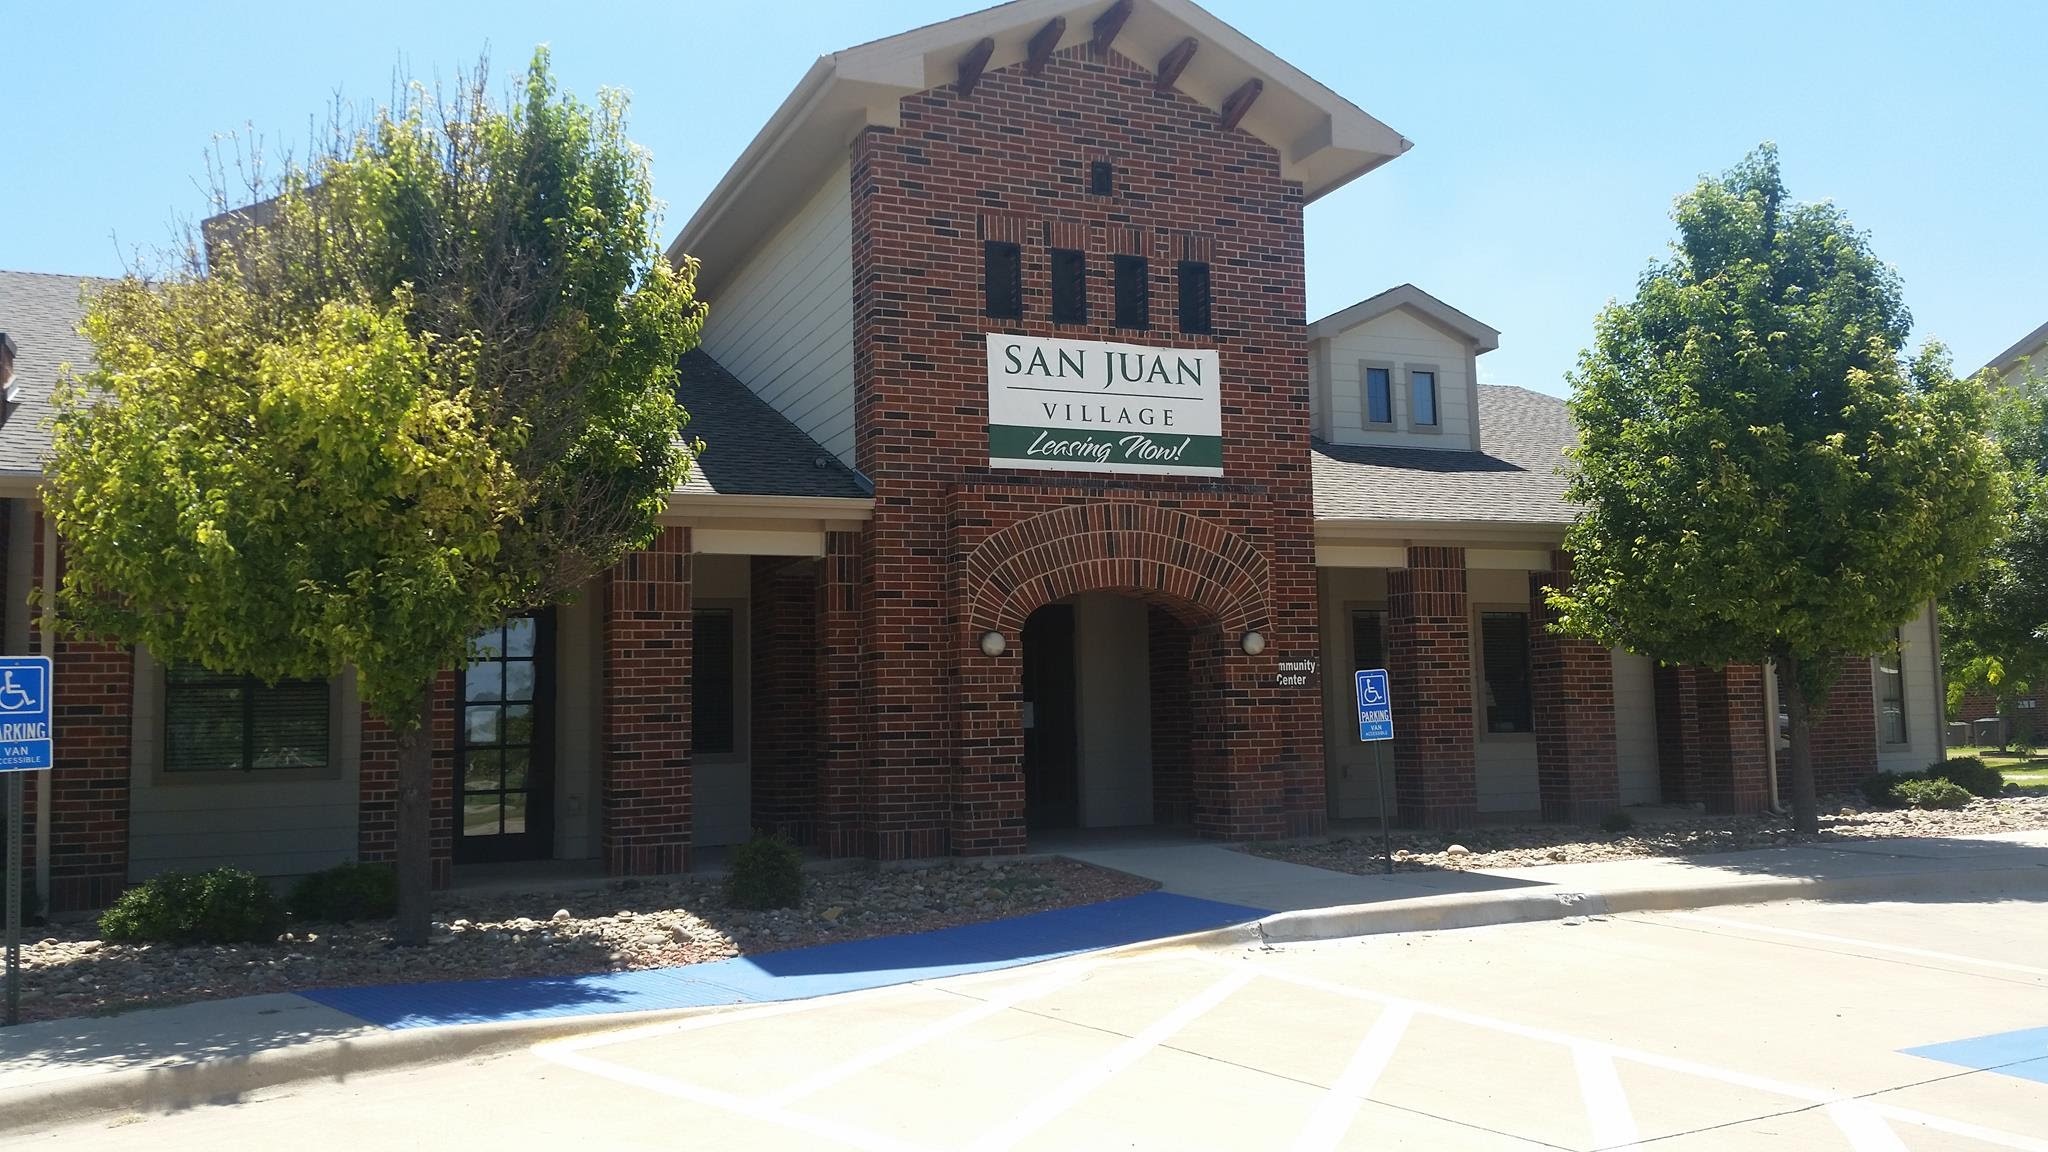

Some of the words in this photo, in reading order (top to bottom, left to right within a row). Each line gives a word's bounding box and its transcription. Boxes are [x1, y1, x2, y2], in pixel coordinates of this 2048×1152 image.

[1004, 344, 1085, 379] SAN
[1103, 351, 1202, 389] JUAN
[1042, 402, 1174, 427] VILLAGE
[1026, 430, 1113, 463] Leasing
[1118, 435, 1191, 461] Now!
[1279, 659, 1316, 674] mmunity
[1276, 673, 1306, 685] Center
[1361, 710, 1389, 722] PARKING
[0, 722, 46, 740] RKING
[4, 746, 29, 756] VAN
[0, 755, 41, 764] CESSIBLE
